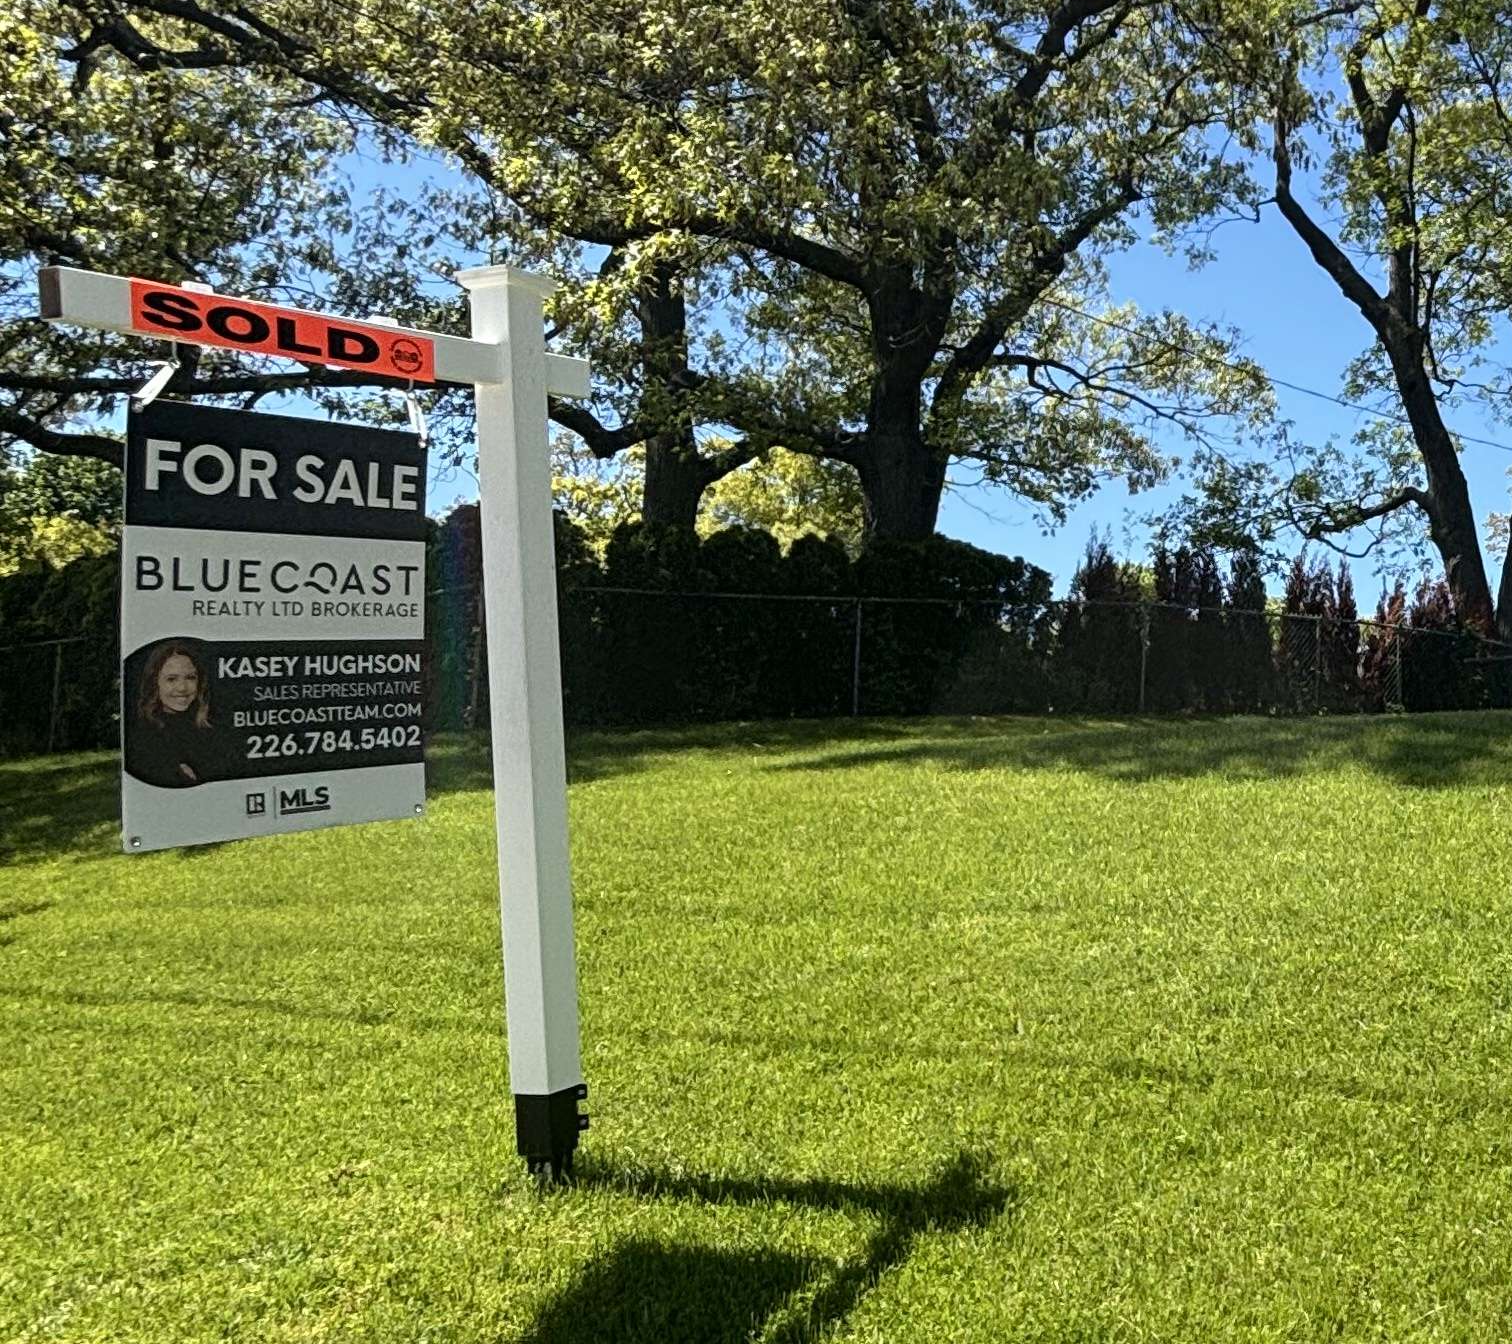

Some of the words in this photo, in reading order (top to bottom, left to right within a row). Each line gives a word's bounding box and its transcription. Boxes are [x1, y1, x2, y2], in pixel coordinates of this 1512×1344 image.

[140, 290, 381, 364] SOLD
[144, 438, 279, 500] FOR
[292, 454, 420, 511] SALE
[135, 556, 419, 596] BLUECOAST
[192, 600, 266, 617] REALTY
[271, 601, 304, 617] LTD
[310, 602, 419, 618] BROKERAGE
[218, 656, 299, 679] KASEY
[303, 654, 421, 676] HUGHSON
[253, 685, 300, 702] SALES
[302, 680, 422, 699] REPRESENTATIVE
[233, 703, 422, 728] BLUECOASTTEAM.COM
[246, 724, 421, 759] 226.784.5402
[280, 786, 330, 809] MLS
